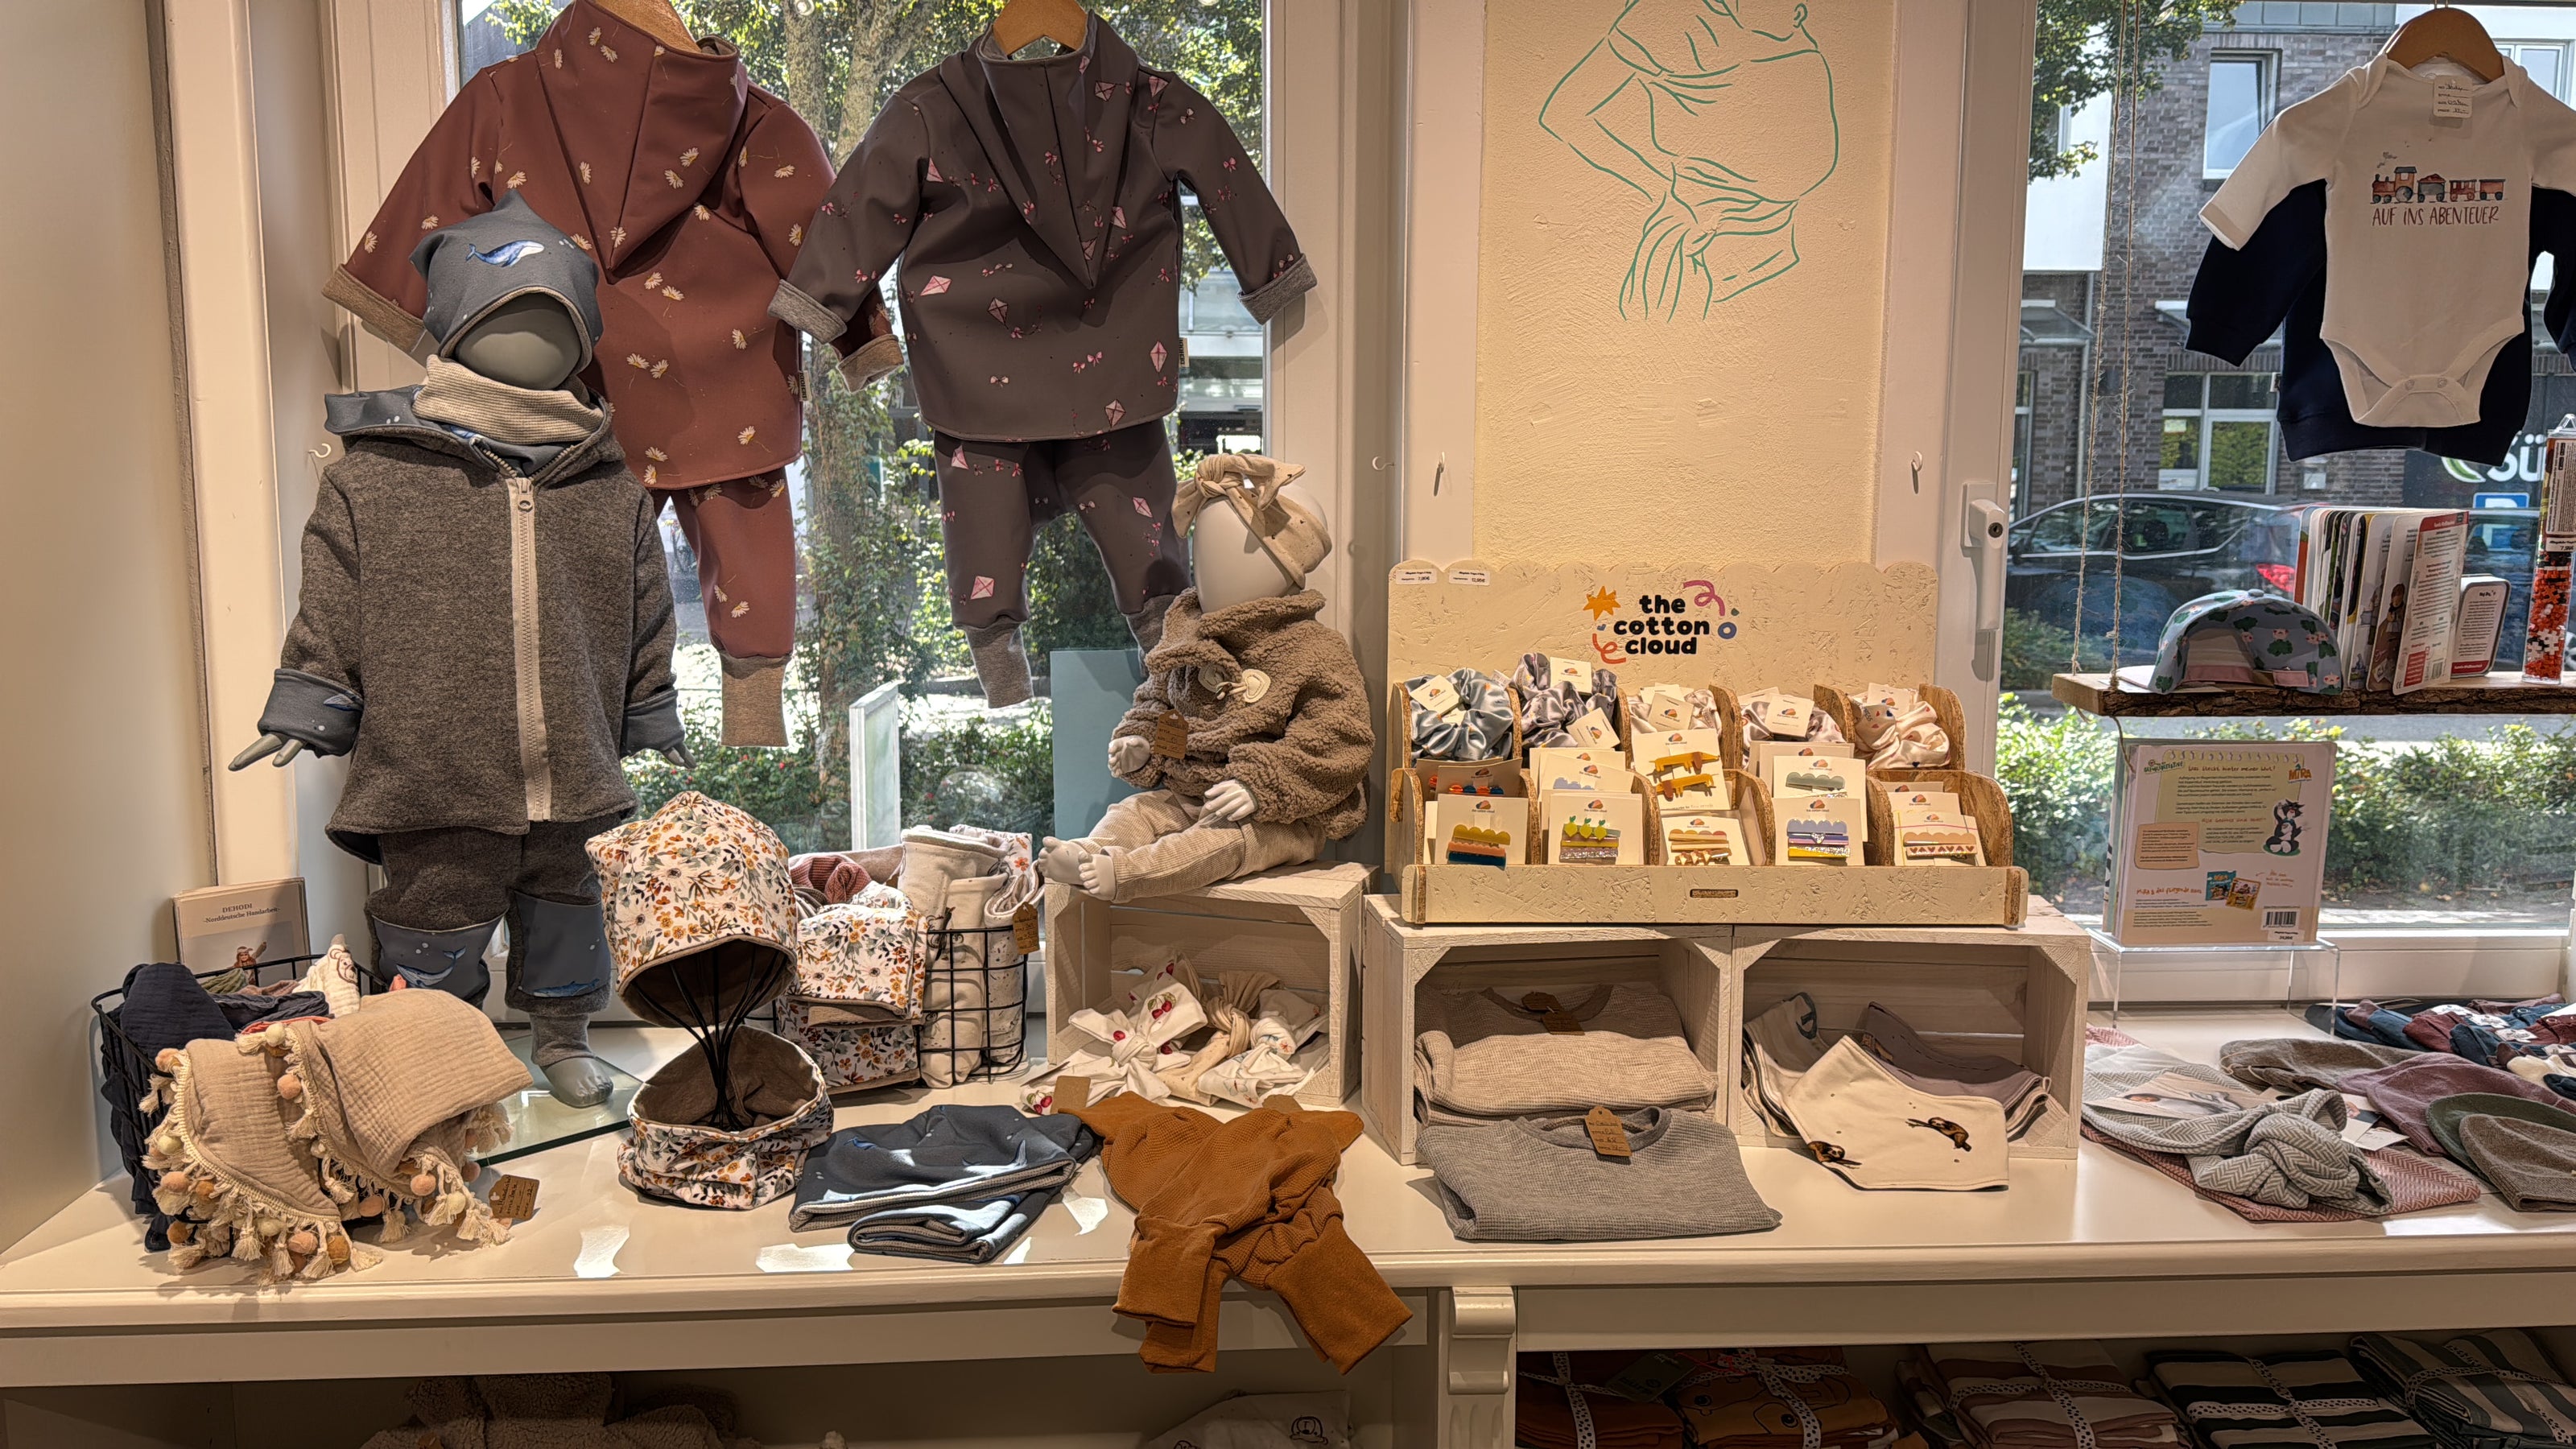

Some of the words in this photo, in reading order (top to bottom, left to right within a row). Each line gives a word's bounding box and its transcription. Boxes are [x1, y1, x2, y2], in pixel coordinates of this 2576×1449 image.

[2372, 207, 2397, 226] AUF
[2429, 206, 2500, 226] ABENTEUER
[1639, 594, 1686, 614] the
[1613, 617, 1710, 636] cotton
[1624, 637, 1698, 655] cloud
[222, 902, 253, 914] DEHODI
